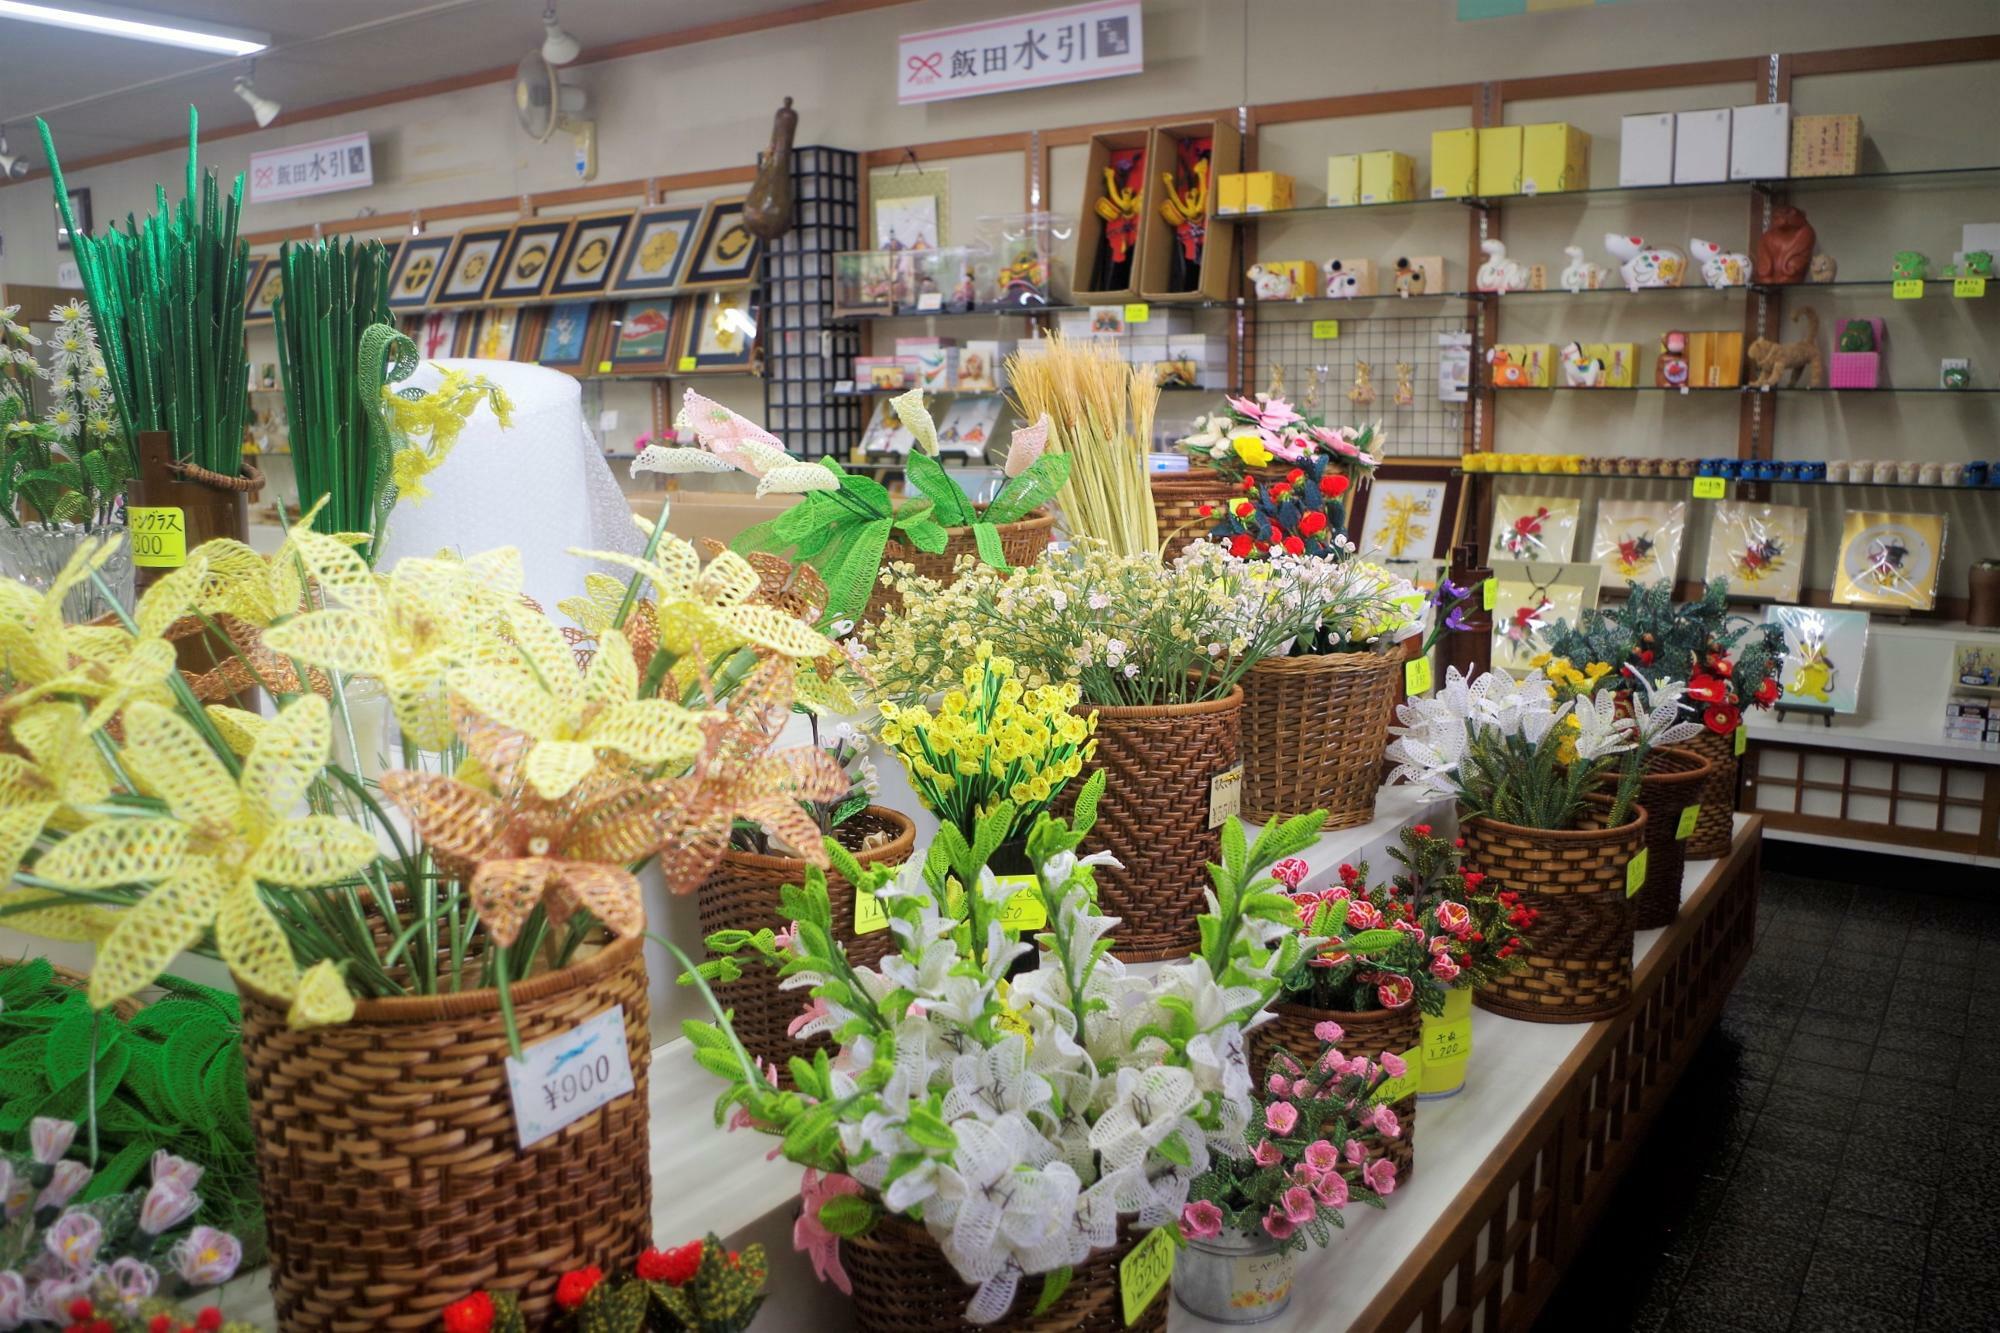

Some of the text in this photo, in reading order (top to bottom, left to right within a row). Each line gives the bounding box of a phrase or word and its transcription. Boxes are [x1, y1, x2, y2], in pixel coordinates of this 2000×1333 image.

[949, 22, 1087, 79] 飯田水引
[277, 148, 346, 185] 飯田水引
[134, 510, 182, 532] ングラス
[542, 1054, 610, 1111] ¥900
